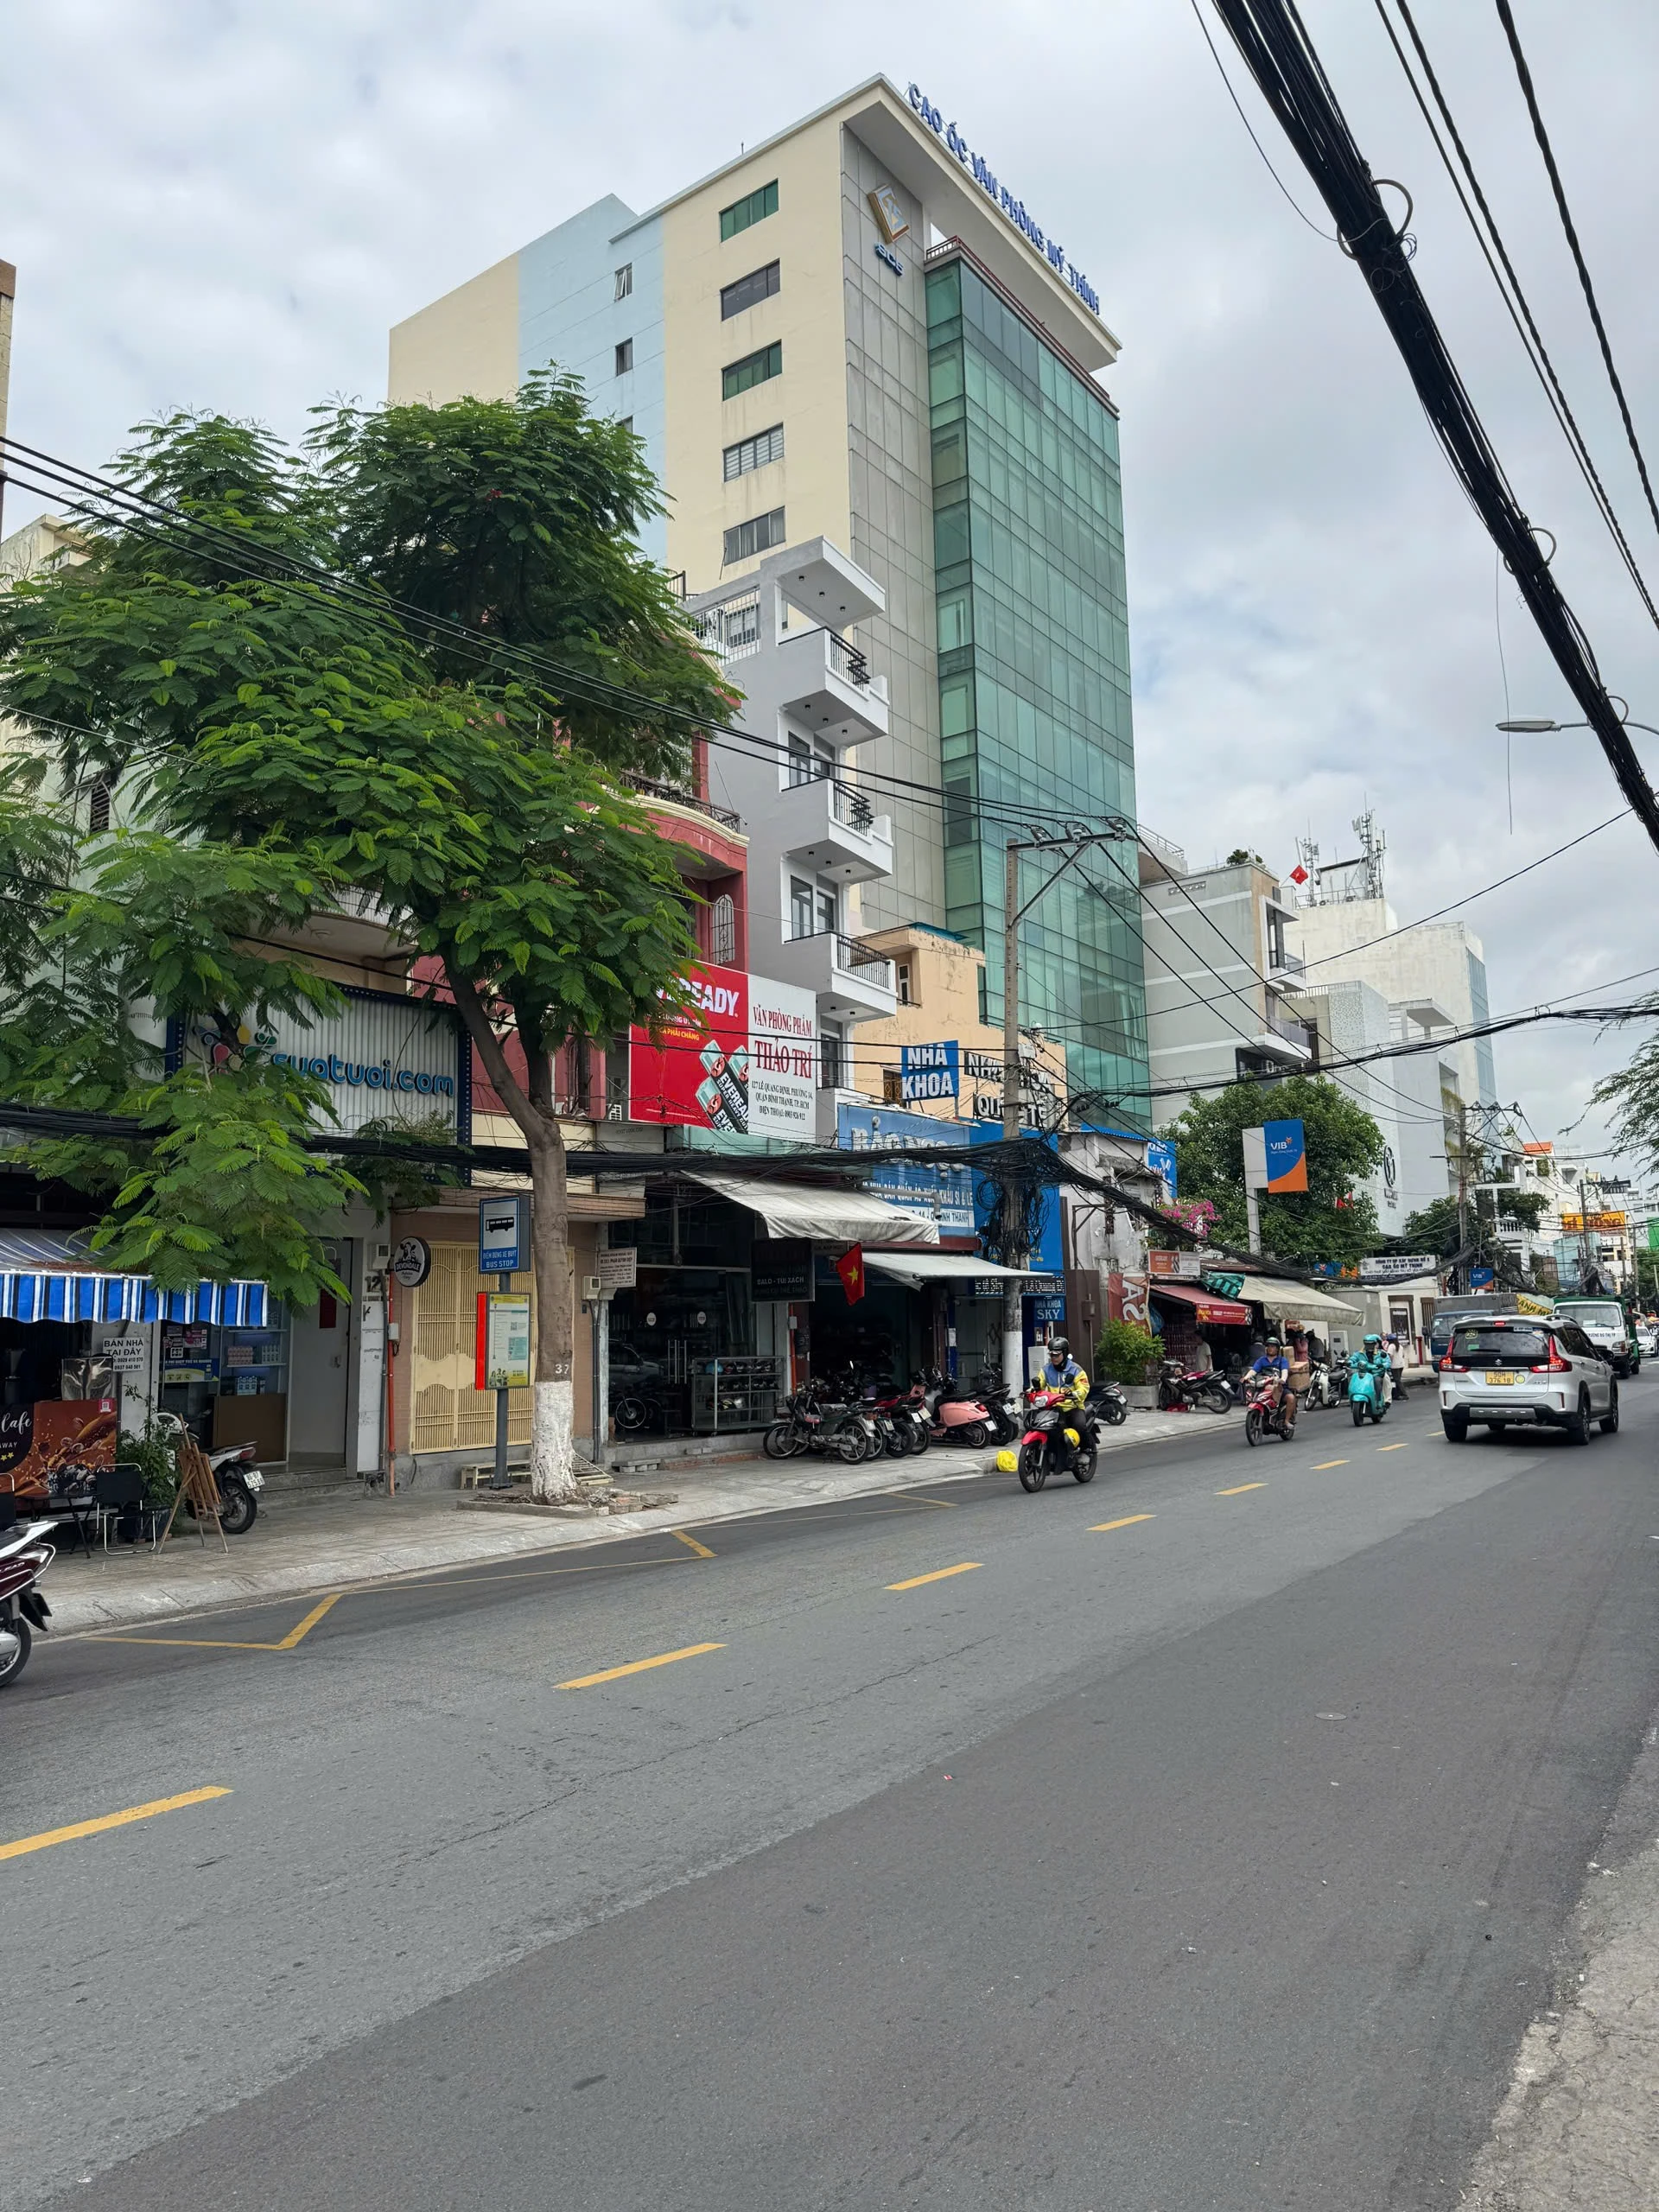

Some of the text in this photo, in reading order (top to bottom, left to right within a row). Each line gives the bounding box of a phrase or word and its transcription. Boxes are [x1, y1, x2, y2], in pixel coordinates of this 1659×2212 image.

[909, 84, 942, 133] CAO
[753, 1004, 767, 1027] VĂN
[768, 1008, 791, 1033] PHÒNG
[755, 1038, 812, 1078] THẢO TRÍ
[902, 1071, 954, 1100] KHOA
[1270, 1141, 1287, 1150] VIB
[1037, 1309, 1060, 1319] SKY
[104, 1338, 123, 1347] BÁN
[124, 1347, 141, 1356] ĐÂY
